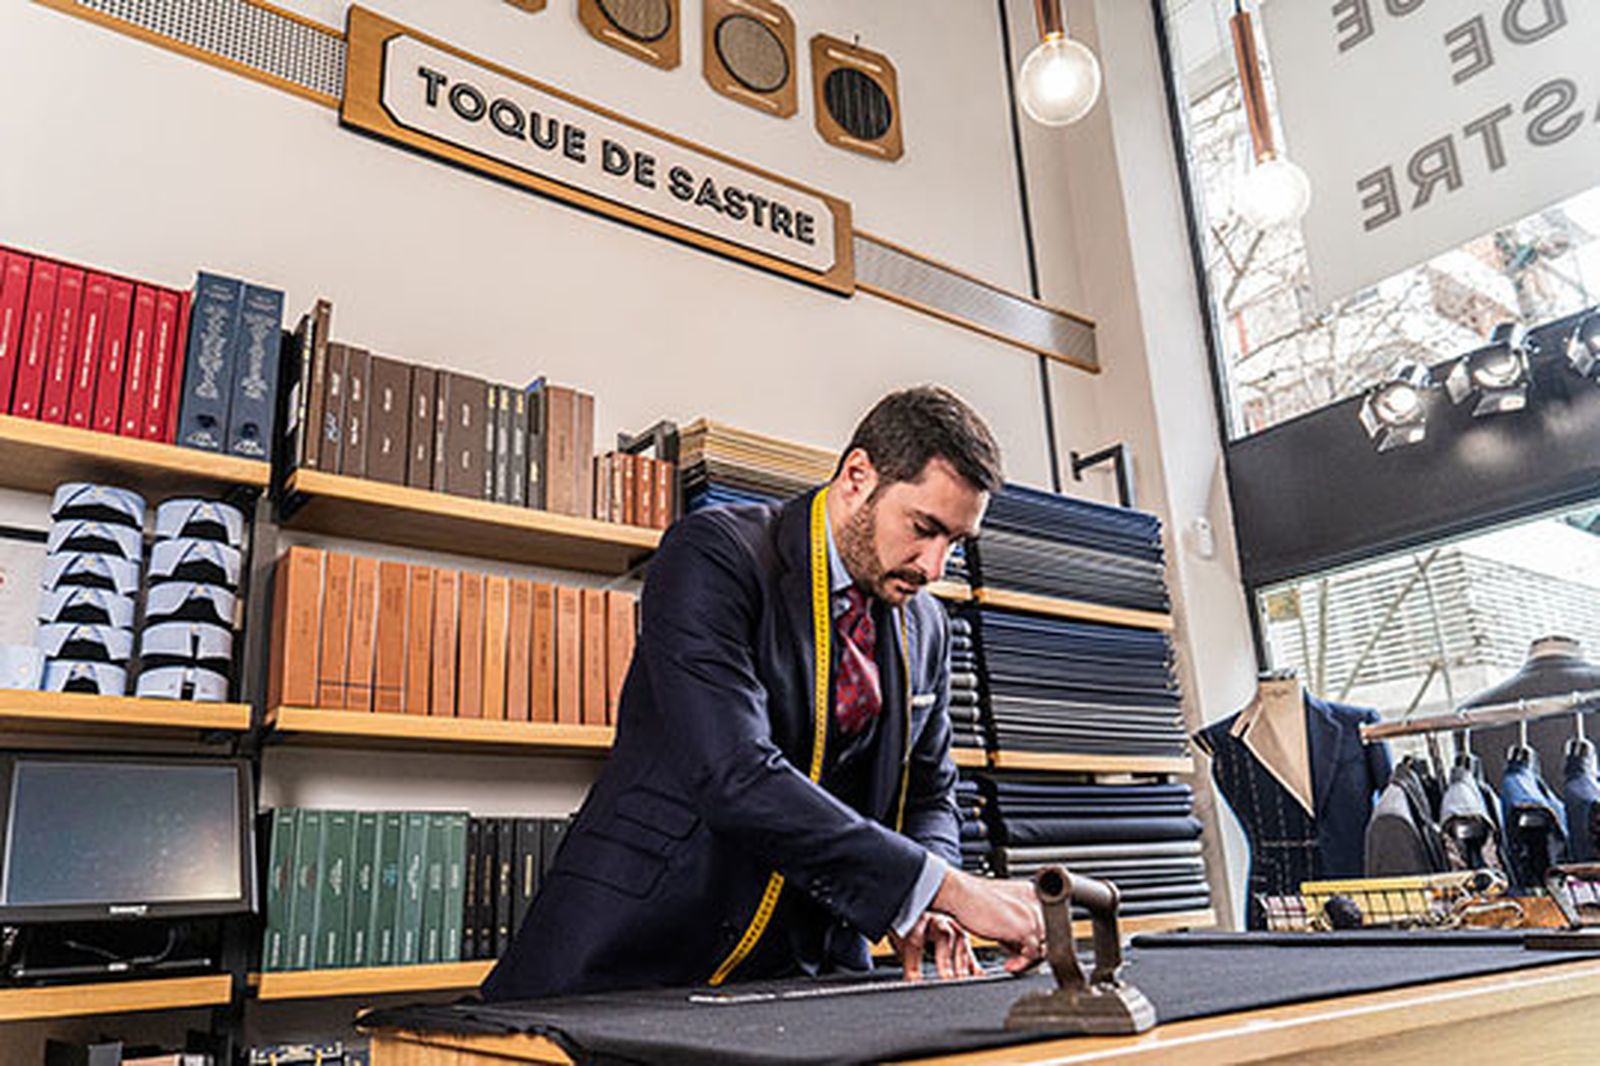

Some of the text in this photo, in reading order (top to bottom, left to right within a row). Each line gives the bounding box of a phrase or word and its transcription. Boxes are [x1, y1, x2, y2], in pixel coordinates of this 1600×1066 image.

[418, 67, 816, 246] TOQUE DE SASTRE
